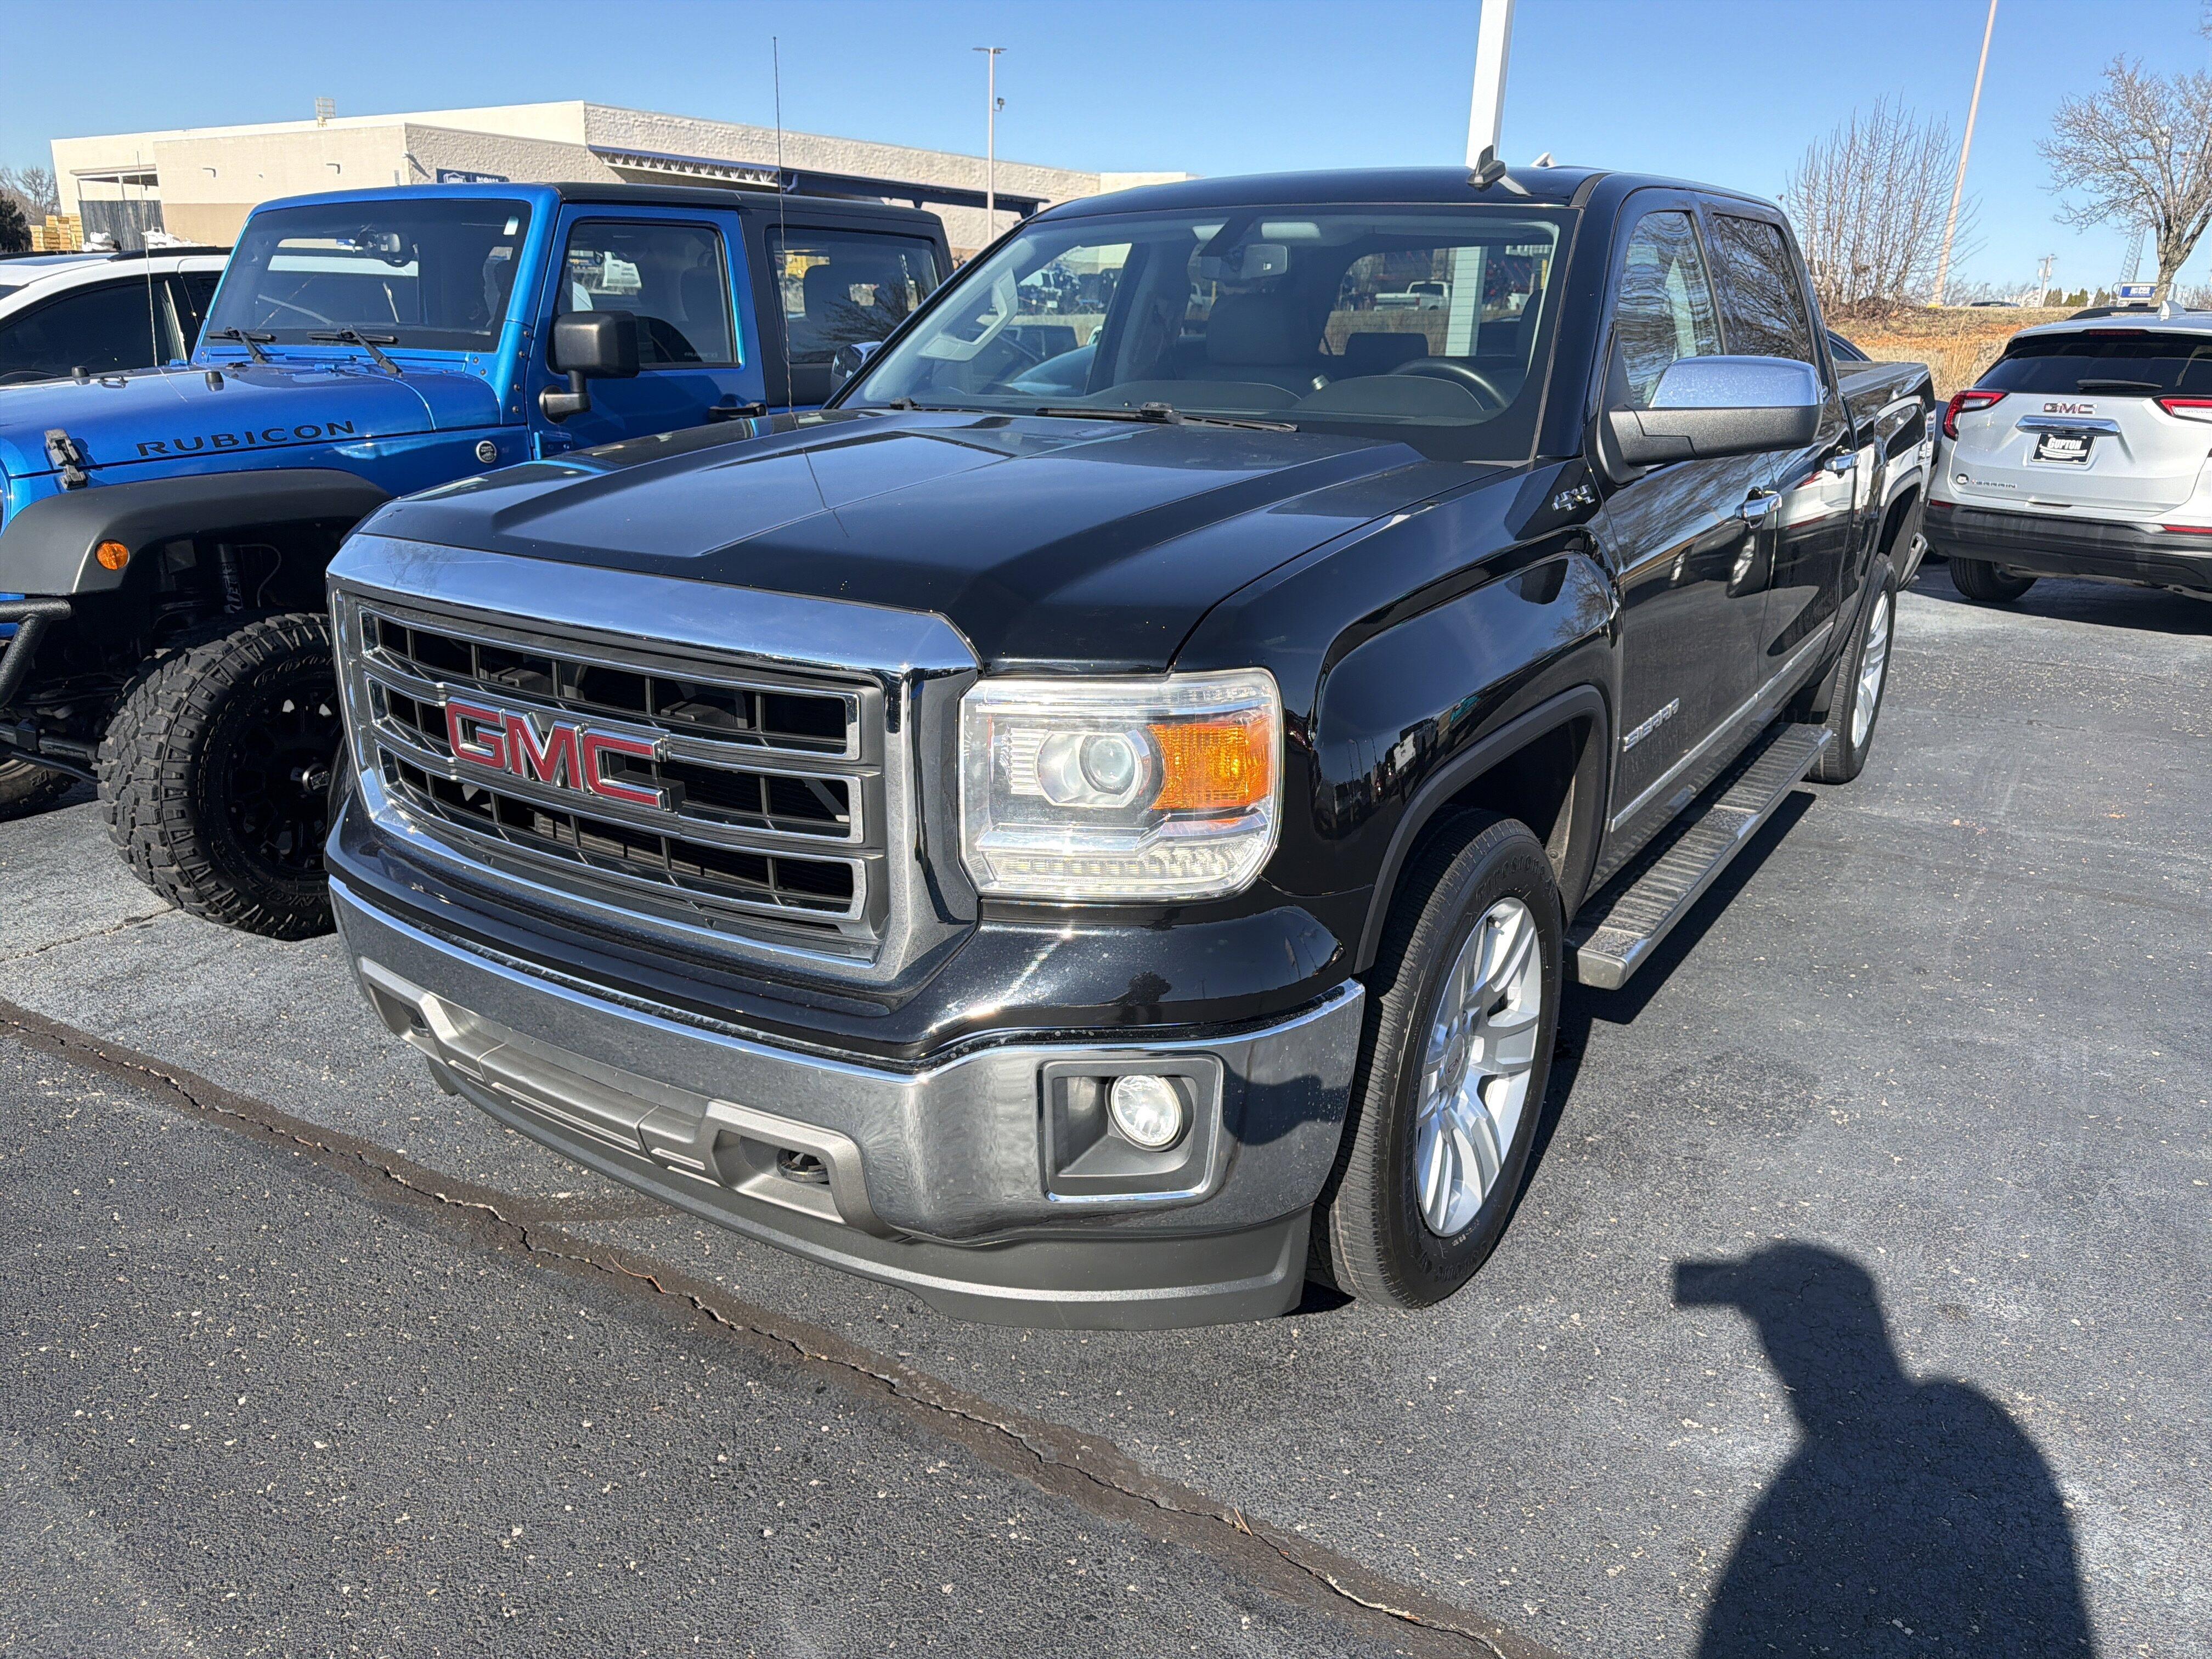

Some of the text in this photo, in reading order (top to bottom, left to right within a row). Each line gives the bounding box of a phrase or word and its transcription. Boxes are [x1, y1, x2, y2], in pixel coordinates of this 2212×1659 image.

[2043, 402, 2097, 414] GMC
[136, 420, 355, 457] RUBICON
[1623, 697, 1680, 752] SIERRA
[445, 697, 671, 814] GMC
